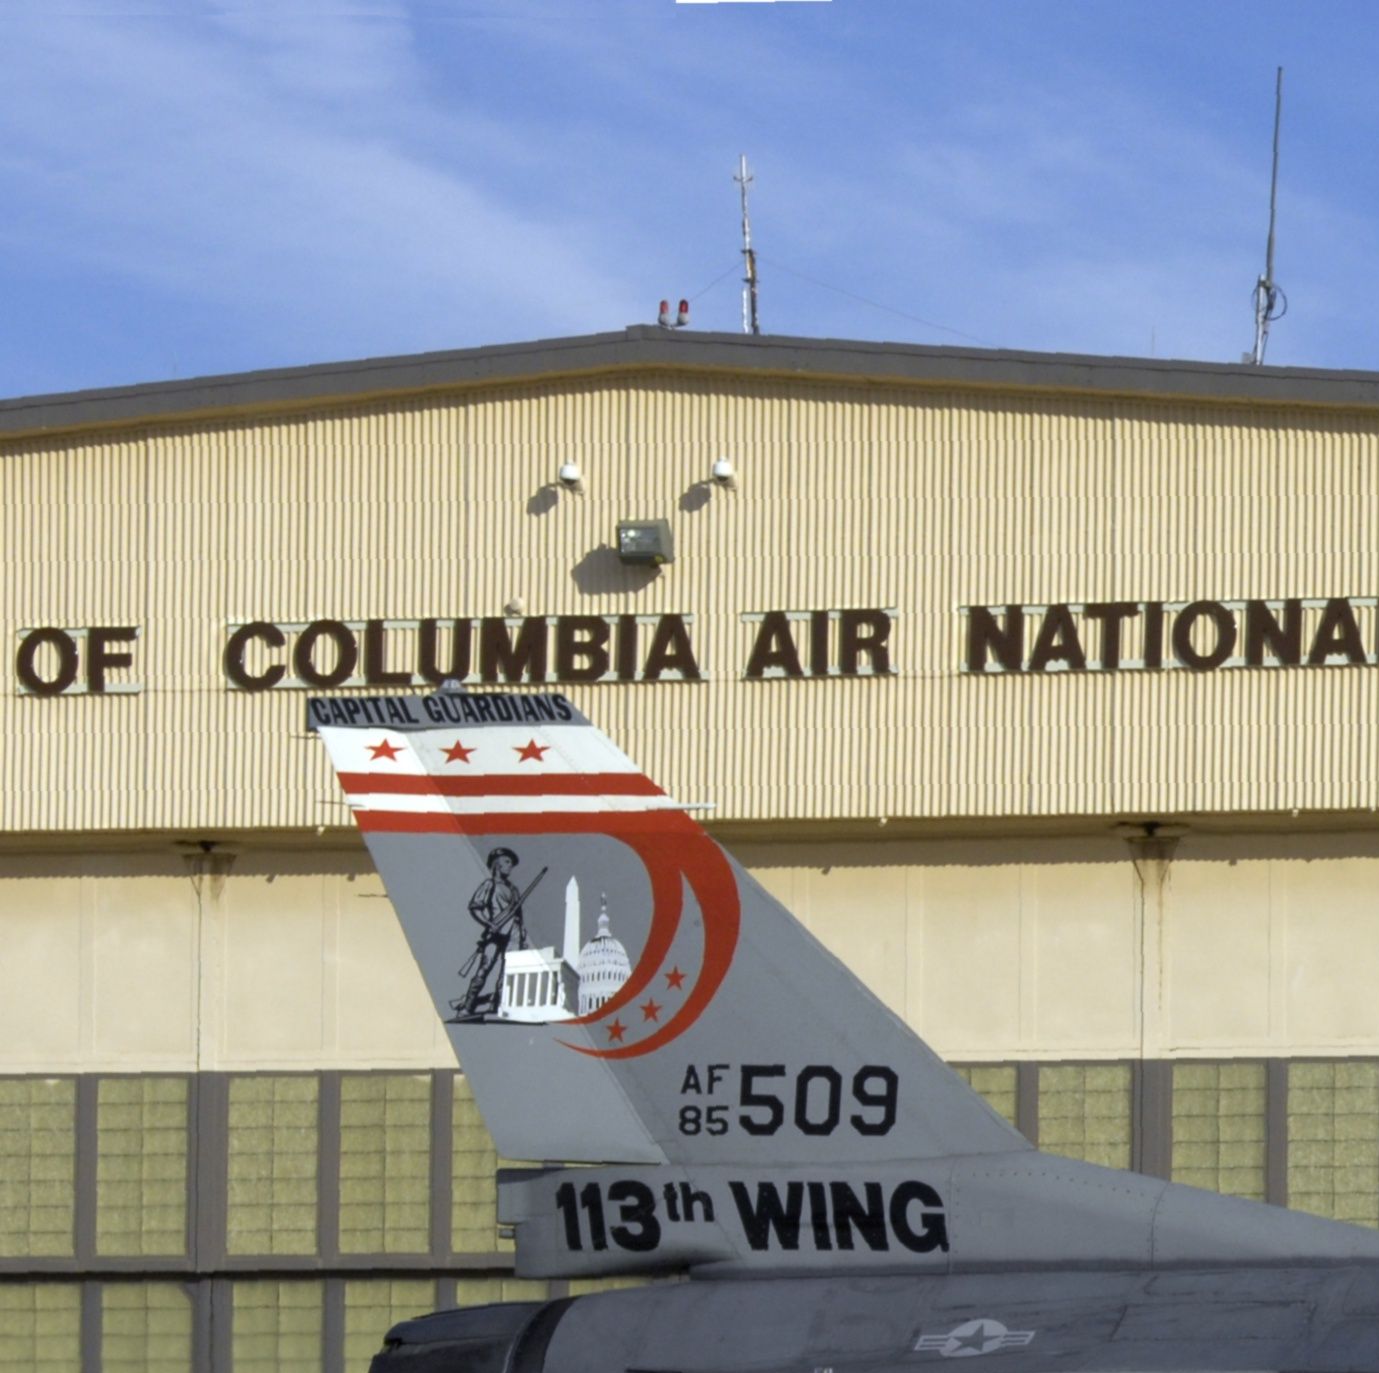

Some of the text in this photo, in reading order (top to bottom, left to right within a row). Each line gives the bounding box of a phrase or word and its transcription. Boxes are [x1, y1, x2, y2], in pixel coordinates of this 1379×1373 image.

[16, 626, 138, 696] OF
[224, 614, 702, 691] COLUMBIA
[744, 609, 892, 680] AIR
[310, 692, 573, 725] CAPITAL GUARDIANS
[680, 1063, 731, 1095] AF
[738, 1063, 899, 1137] 509
[678, 1104, 730, 1136] 85
[555, 1180, 950, 1254] 113th WING
